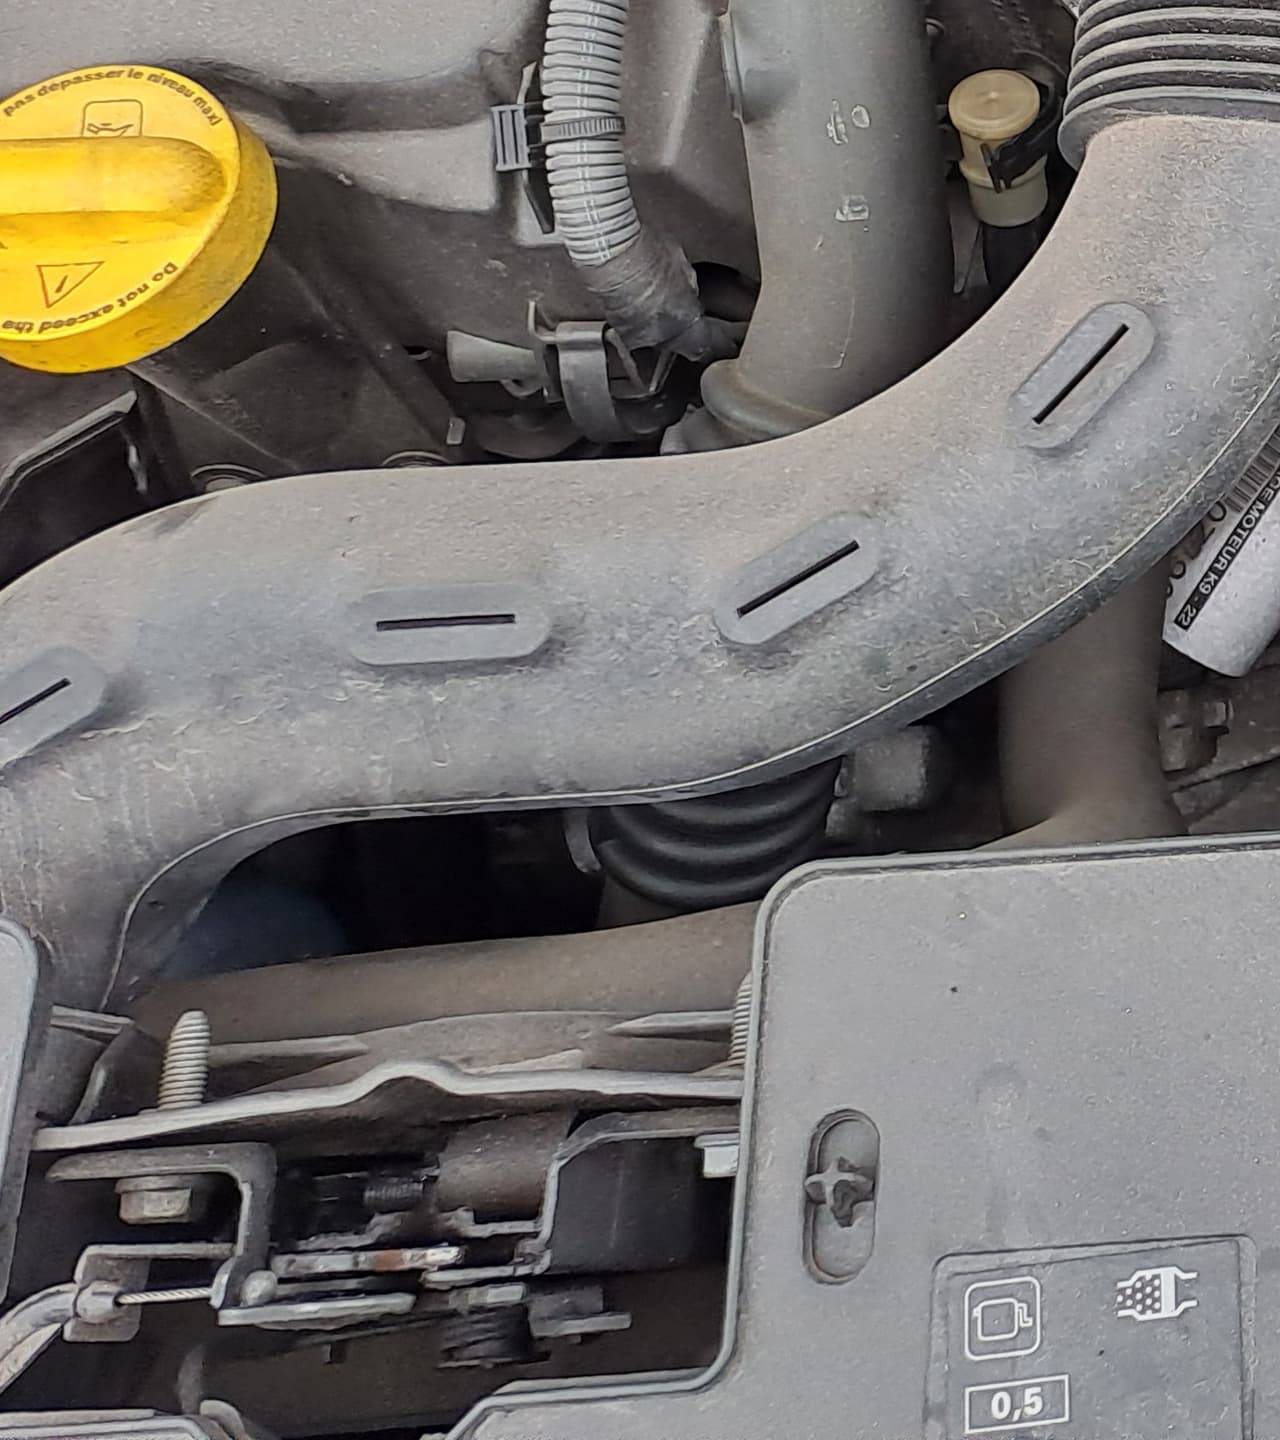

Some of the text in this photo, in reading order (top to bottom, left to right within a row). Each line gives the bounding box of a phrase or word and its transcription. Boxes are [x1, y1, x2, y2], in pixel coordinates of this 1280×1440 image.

[3, 94, 34, 117] pas
[127, 68, 144, 79] le
[147, 73, 195, 99] niveau
[1, 262, 179, 333] Do not exceed the
[1215, 501, 1266, 570] MOTEUR
[1198, 570, 1220, 595] K9
[1178, 604, 1198, 628] 22
[990, 1387, 1044, 1423] 0,5
